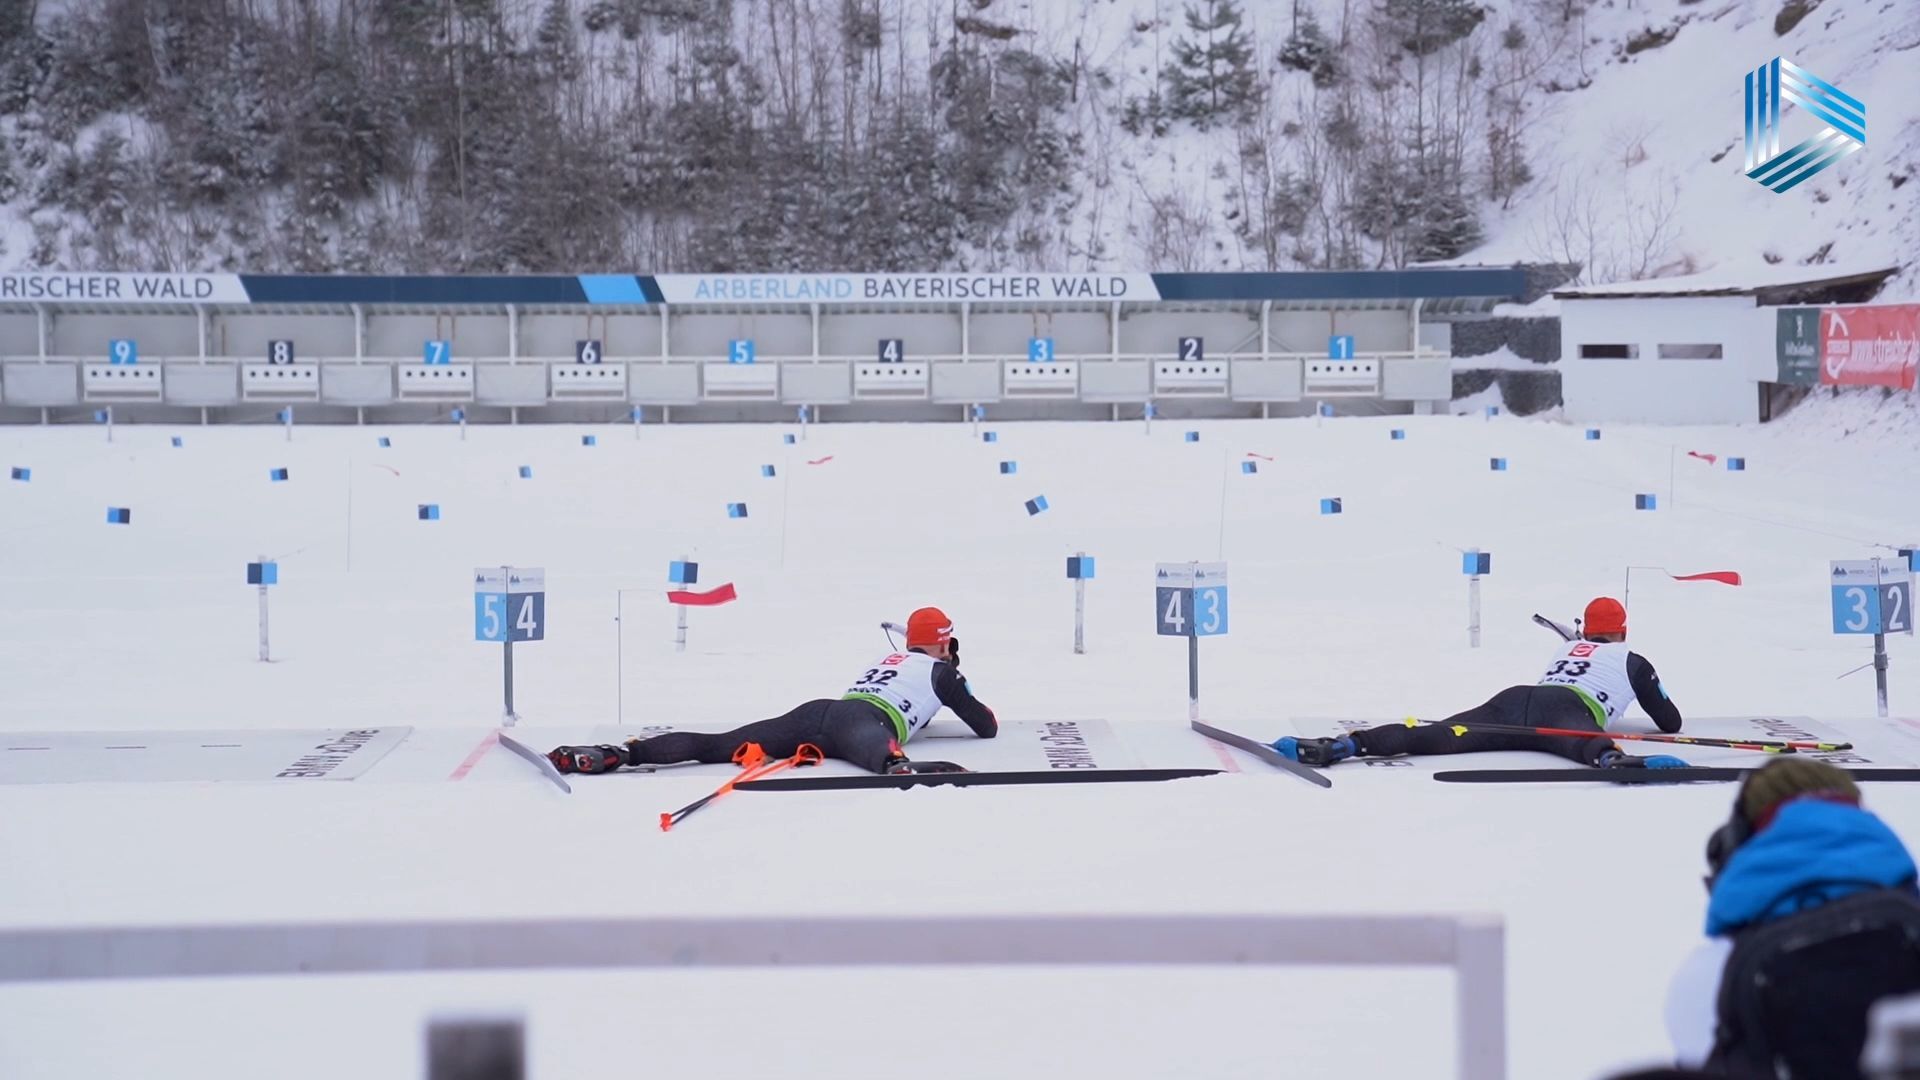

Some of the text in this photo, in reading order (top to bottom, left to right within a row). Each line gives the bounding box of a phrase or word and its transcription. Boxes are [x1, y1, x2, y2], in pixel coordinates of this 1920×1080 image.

[2, 276, 213, 298] RISCHER WALD
[695, 277, 1127, 299] ARBERLAND BAYERISCHER WALD
[115, 340, 130, 364] 9
[274, 341, 288, 364] 8
[430, 341, 444, 364] 7
[581, 341, 596, 364] 6
[735, 340, 748, 364] 5
[883, 340, 898, 363] 4
[1035, 339, 1048, 362] 3
[1184, 338, 1198, 361] 2
[1336, 337, 1346, 359] 1
[483, 595, 499, 638] 5
[516, 595, 537, 638] 4
[1165, 590, 1185, 632] 4
[1203, 589, 1219, 633] 3
[1845, 587, 1869, 631] 3
[1887, 585, 1904, 630] 2
[856, 669, 898, 686] 32
[1547, 660, 1591, 677] 33
